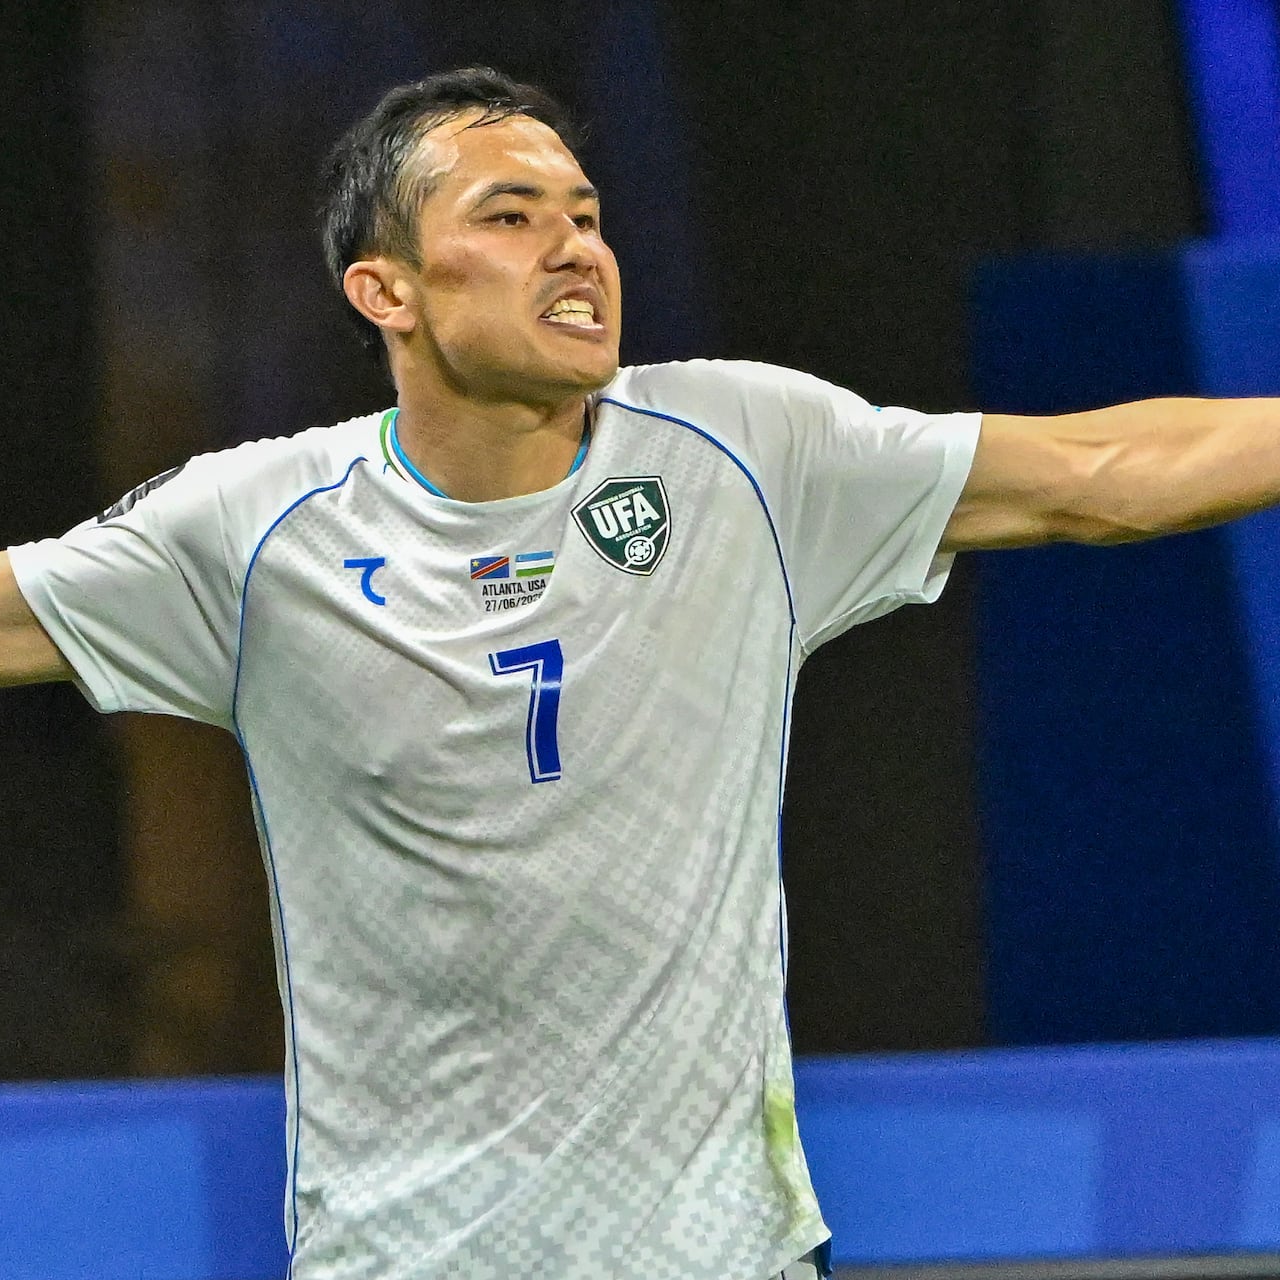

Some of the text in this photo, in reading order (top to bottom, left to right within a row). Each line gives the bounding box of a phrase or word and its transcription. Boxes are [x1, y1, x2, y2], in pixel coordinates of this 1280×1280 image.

[590, 491, 661, 539] UFA
[482, 579, 546, 597] ATLANTA, USA
[488, 638, 563, 784] 7
